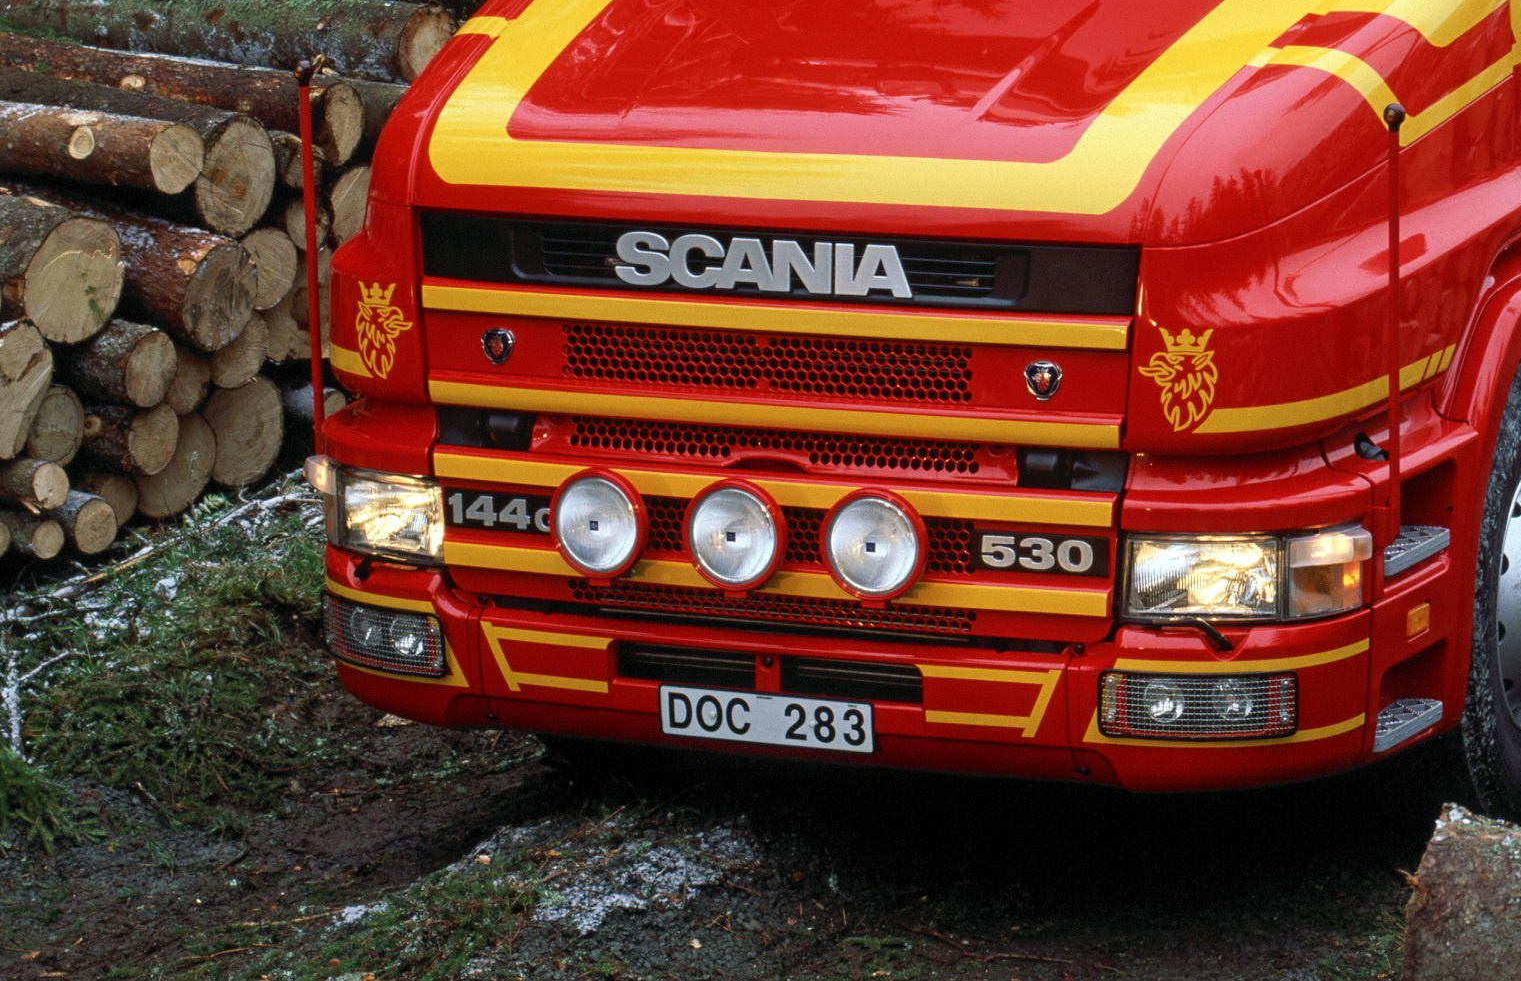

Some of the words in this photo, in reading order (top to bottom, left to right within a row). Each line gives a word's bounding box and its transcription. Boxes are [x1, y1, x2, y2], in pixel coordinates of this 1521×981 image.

[614, 231, 913, 299] SCANIA
[981, 535, 1094, 573] 530
[668, 692, 751, 736] DOC
[784, 703, 866, 747] 283
